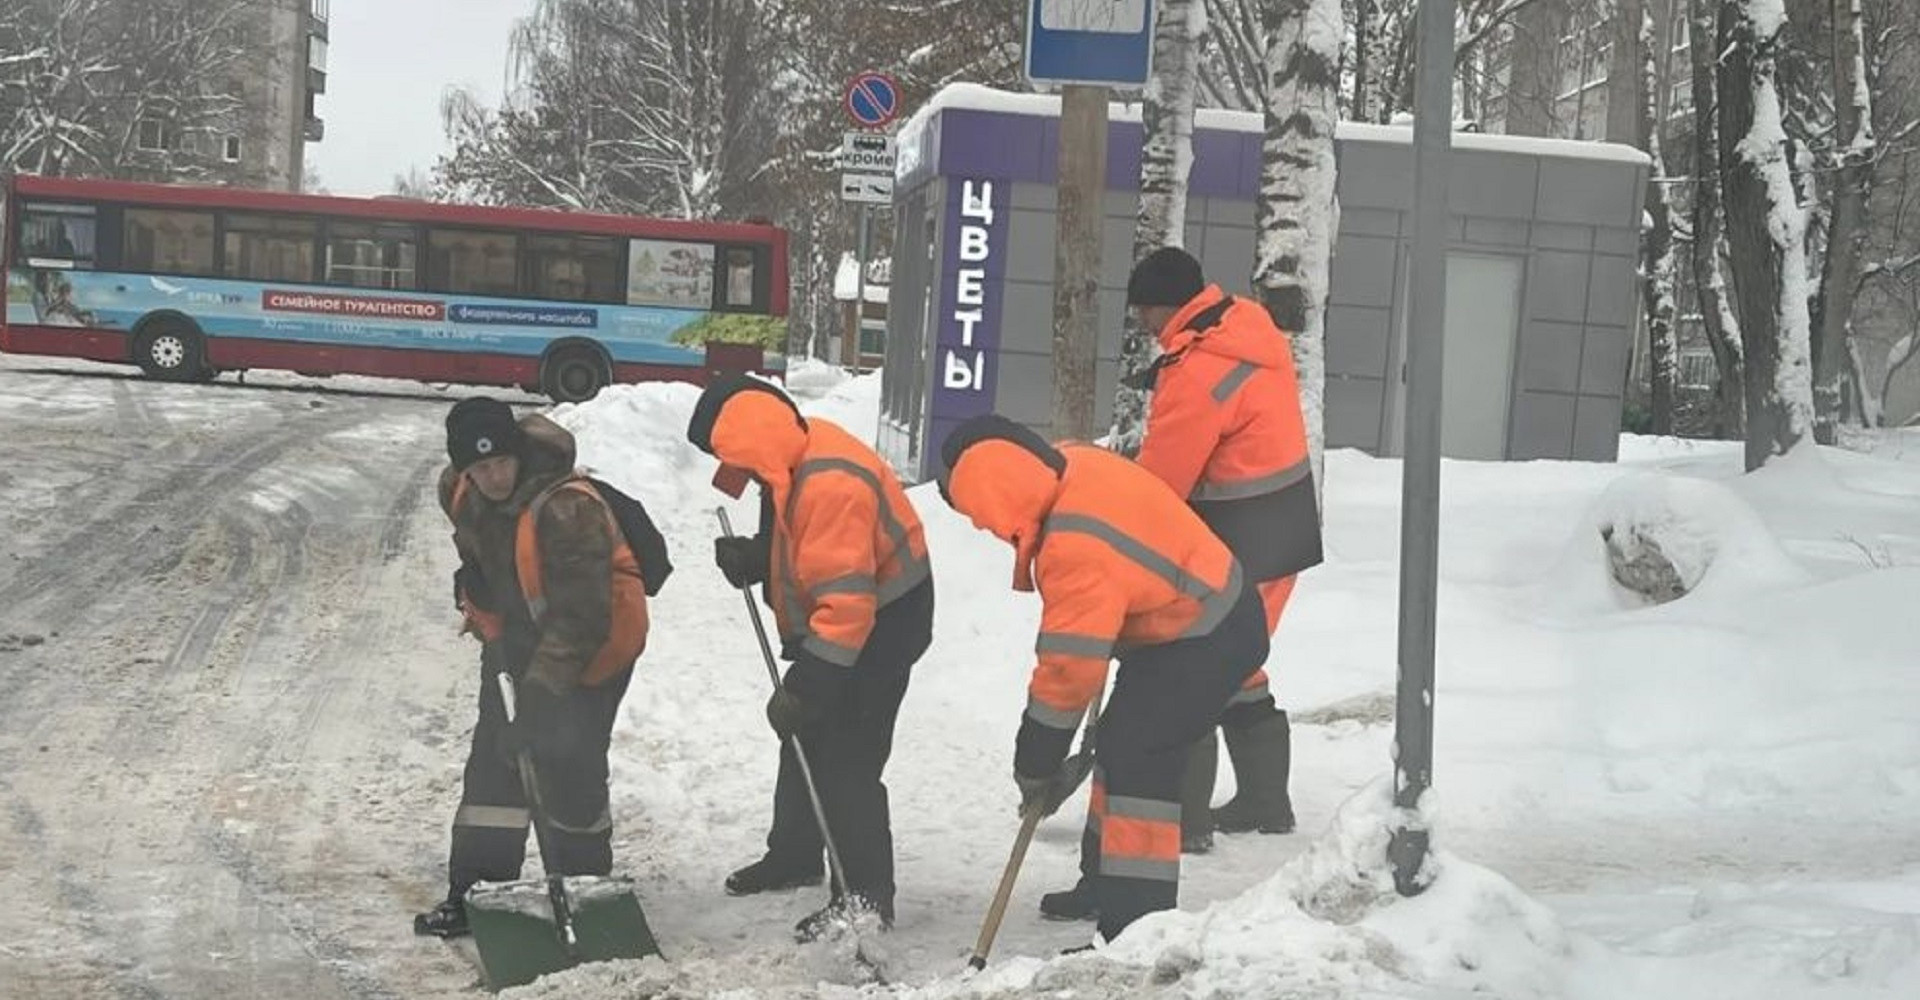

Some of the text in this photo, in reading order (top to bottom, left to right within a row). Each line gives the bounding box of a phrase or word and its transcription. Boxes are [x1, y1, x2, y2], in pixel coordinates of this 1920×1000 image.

[844, 152, 894, 167] кроме
[944, 180, 993, 391] ЦВЕТЫ
[270, 294, 437, 316] СЕМЕЙНОЕ ТУРАГЕНТСТВО
